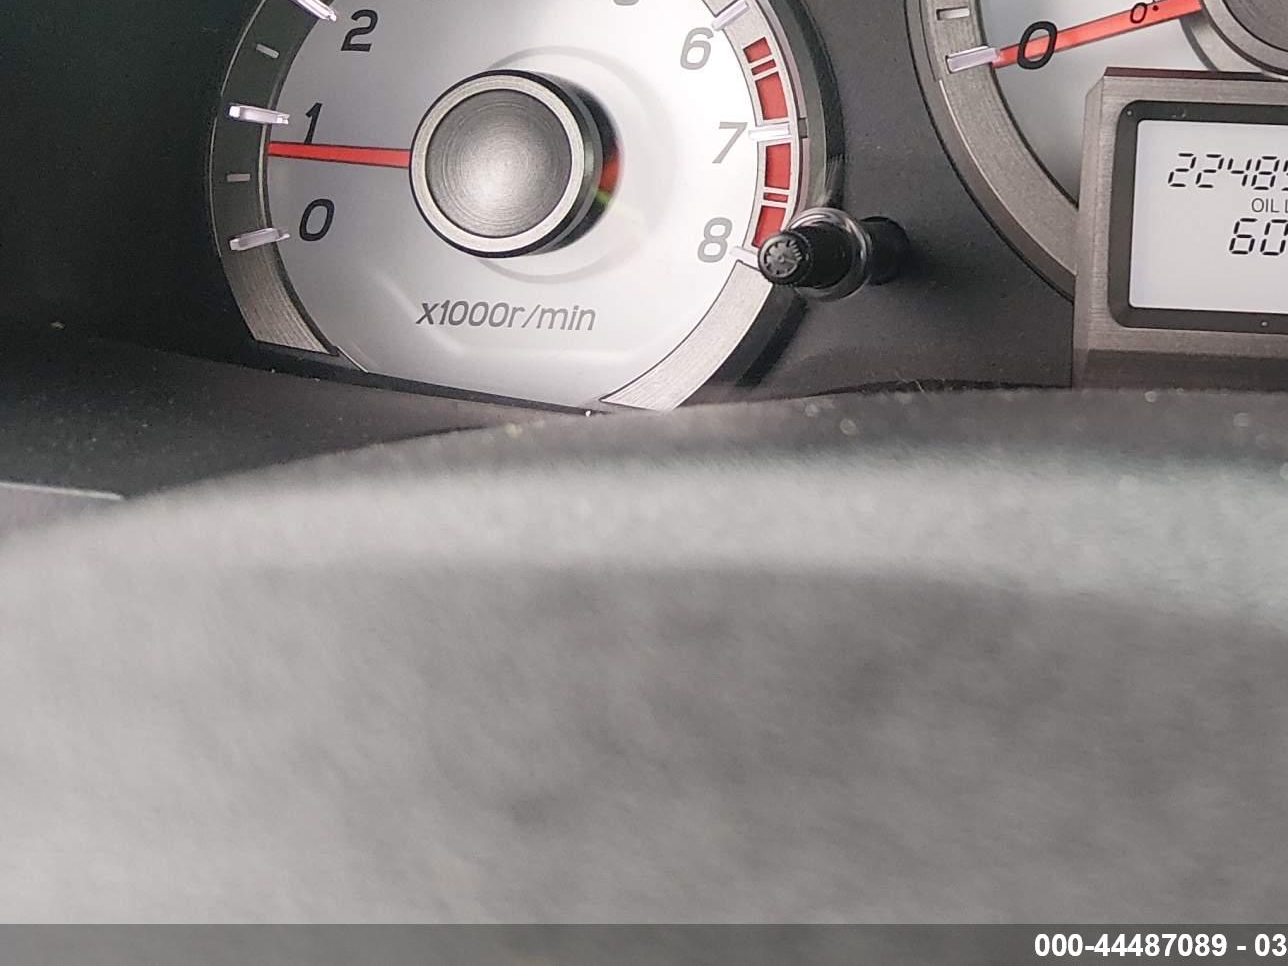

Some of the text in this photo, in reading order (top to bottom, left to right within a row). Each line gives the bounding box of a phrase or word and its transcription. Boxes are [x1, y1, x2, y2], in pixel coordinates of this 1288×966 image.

[341, 10, 378, 52] 2
[1129, 2, 1148, 25] 0
[680, 27, 713, 70] 6
[1017, 21, 1057, 71] 0
[303, 103, 324, 145] 1
[712, 122, 748, 163] 7
[299, 199, 334, 242] 0
[1251, 198, 1280, 214] OIL
[697, 218, 733, 263] 8
[416, 301, 596, 331] x1000r/min
